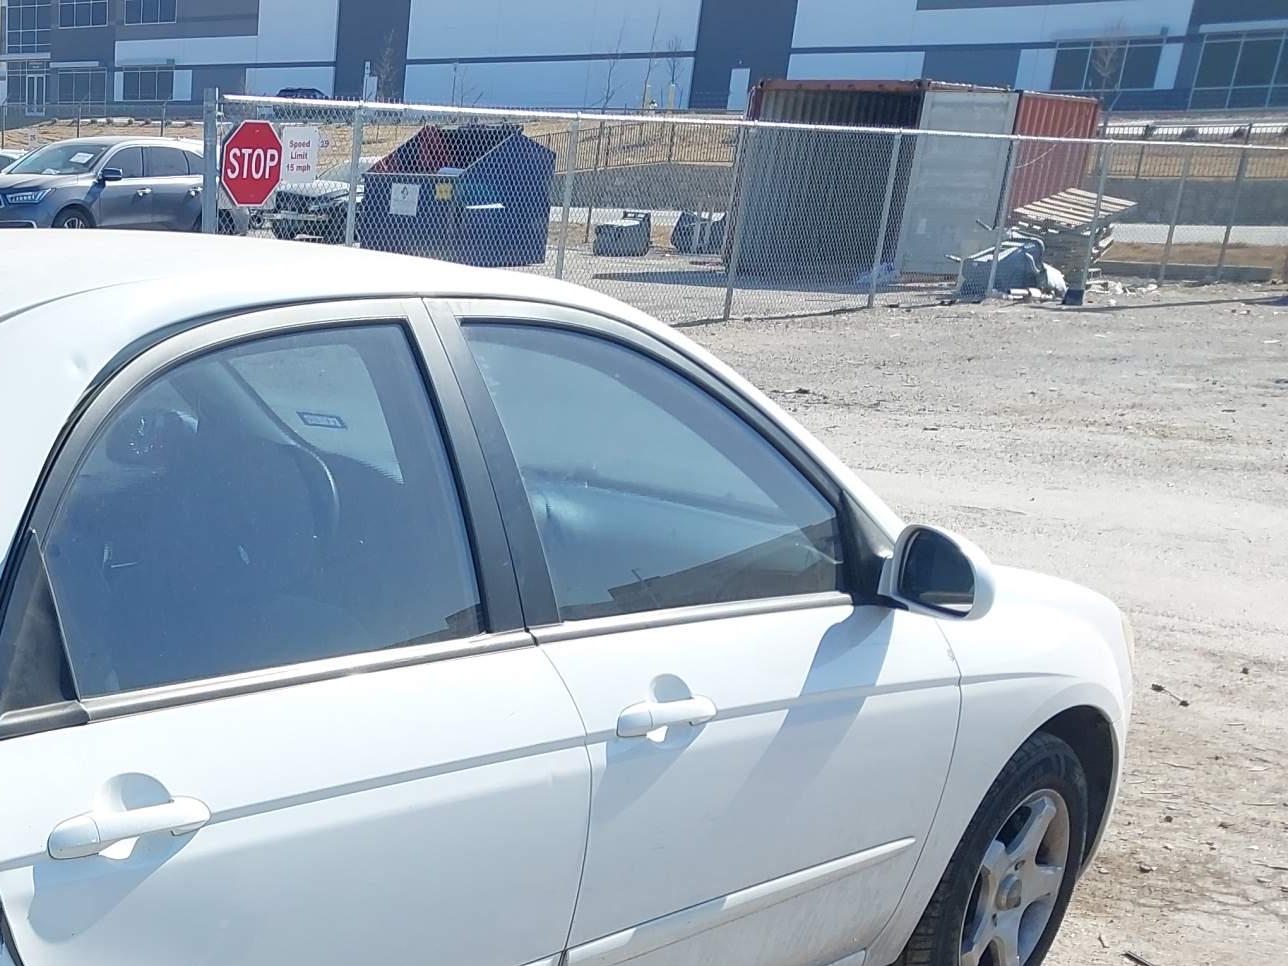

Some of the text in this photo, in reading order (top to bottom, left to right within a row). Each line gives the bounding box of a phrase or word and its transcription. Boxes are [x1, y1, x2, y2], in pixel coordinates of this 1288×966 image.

[289, 140, 311, 149] Speed
[290, 152, 308, 160] Limit
[226, 147, 279, 179] STOP
[286, 163, 311, 172] 15 mph
